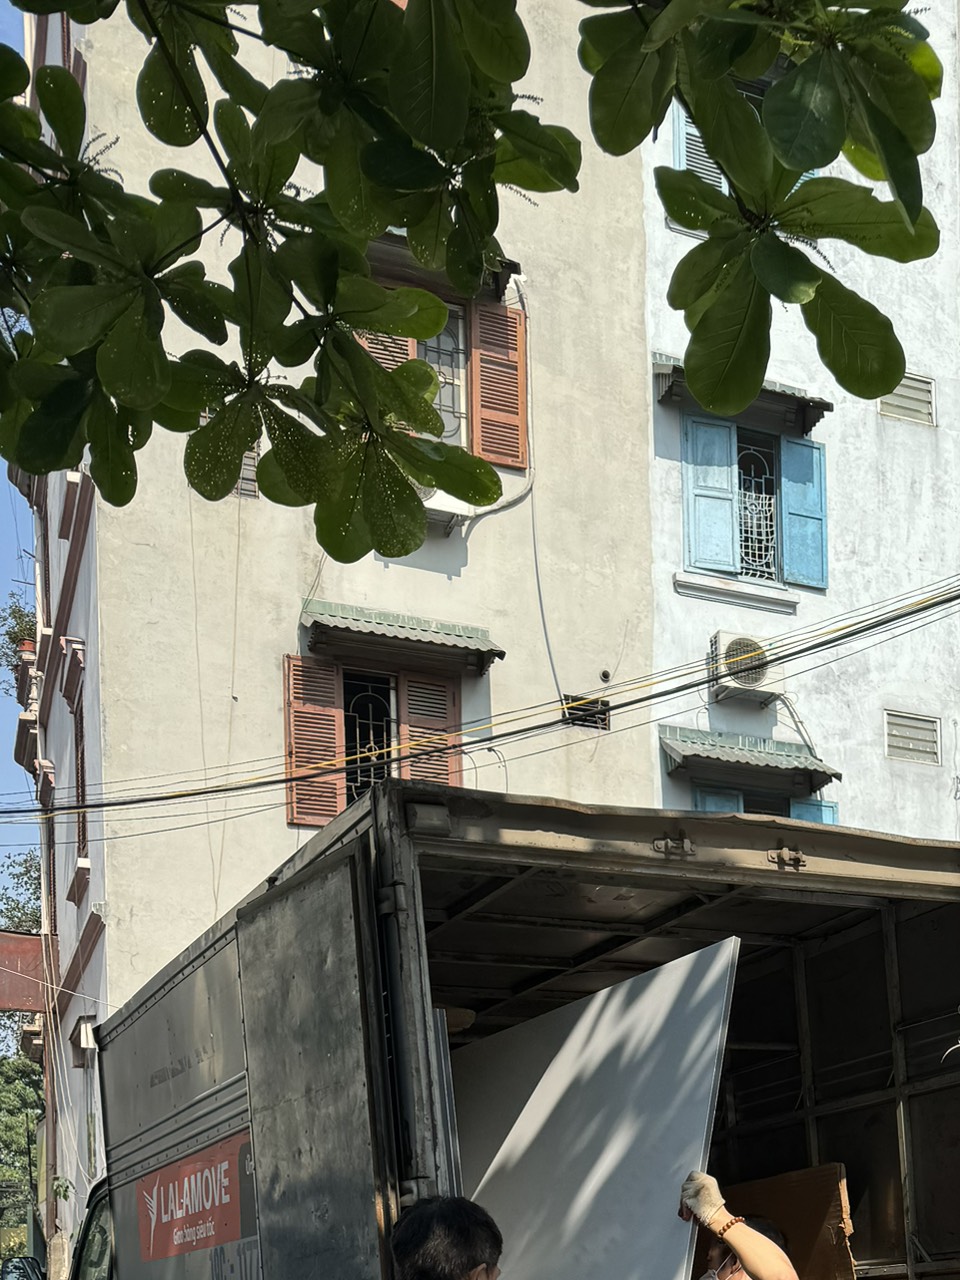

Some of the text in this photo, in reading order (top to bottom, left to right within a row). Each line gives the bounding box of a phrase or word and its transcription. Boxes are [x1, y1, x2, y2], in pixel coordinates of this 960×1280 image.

[161, 1161, 230, 1223] LALAMOVE
[173, 1216, 215, 1245] Giao hàng siêu tốc
